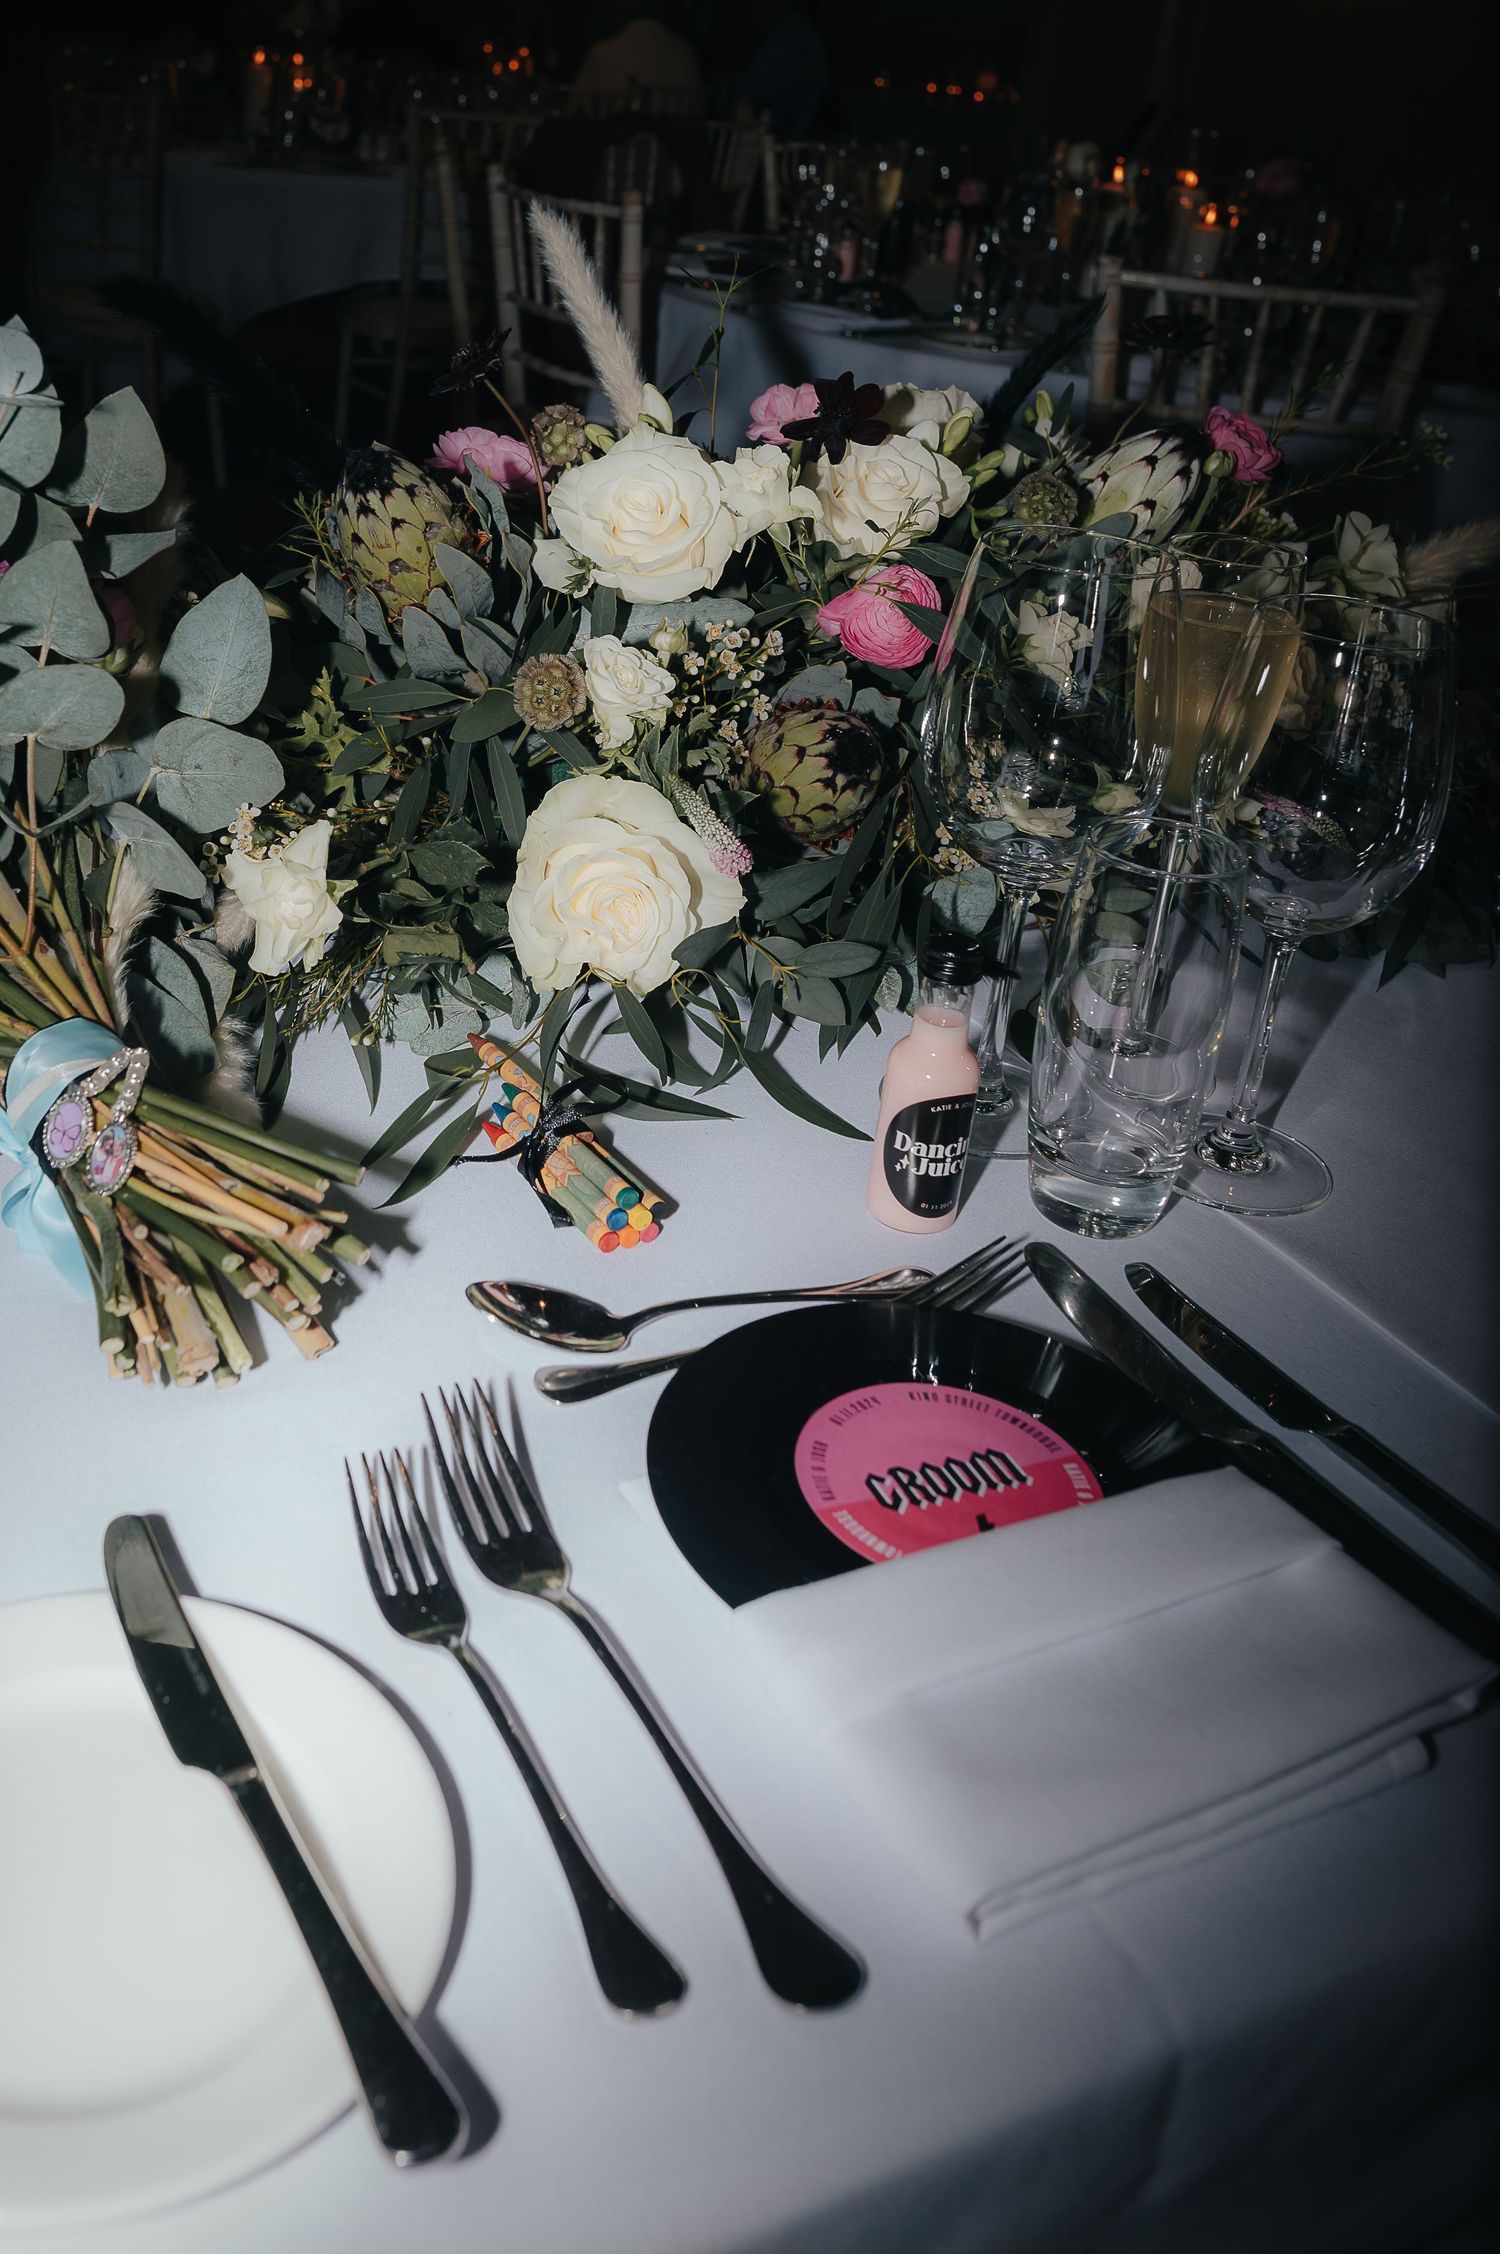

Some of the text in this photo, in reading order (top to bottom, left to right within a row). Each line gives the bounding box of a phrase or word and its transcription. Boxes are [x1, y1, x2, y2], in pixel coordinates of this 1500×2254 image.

[930, 1104, 951, 1112] KATIE
[907, 1391, 1063, 1453] KING STREET TOWNHOUSE
[866, 1448, 1035, 1516] GROOM
